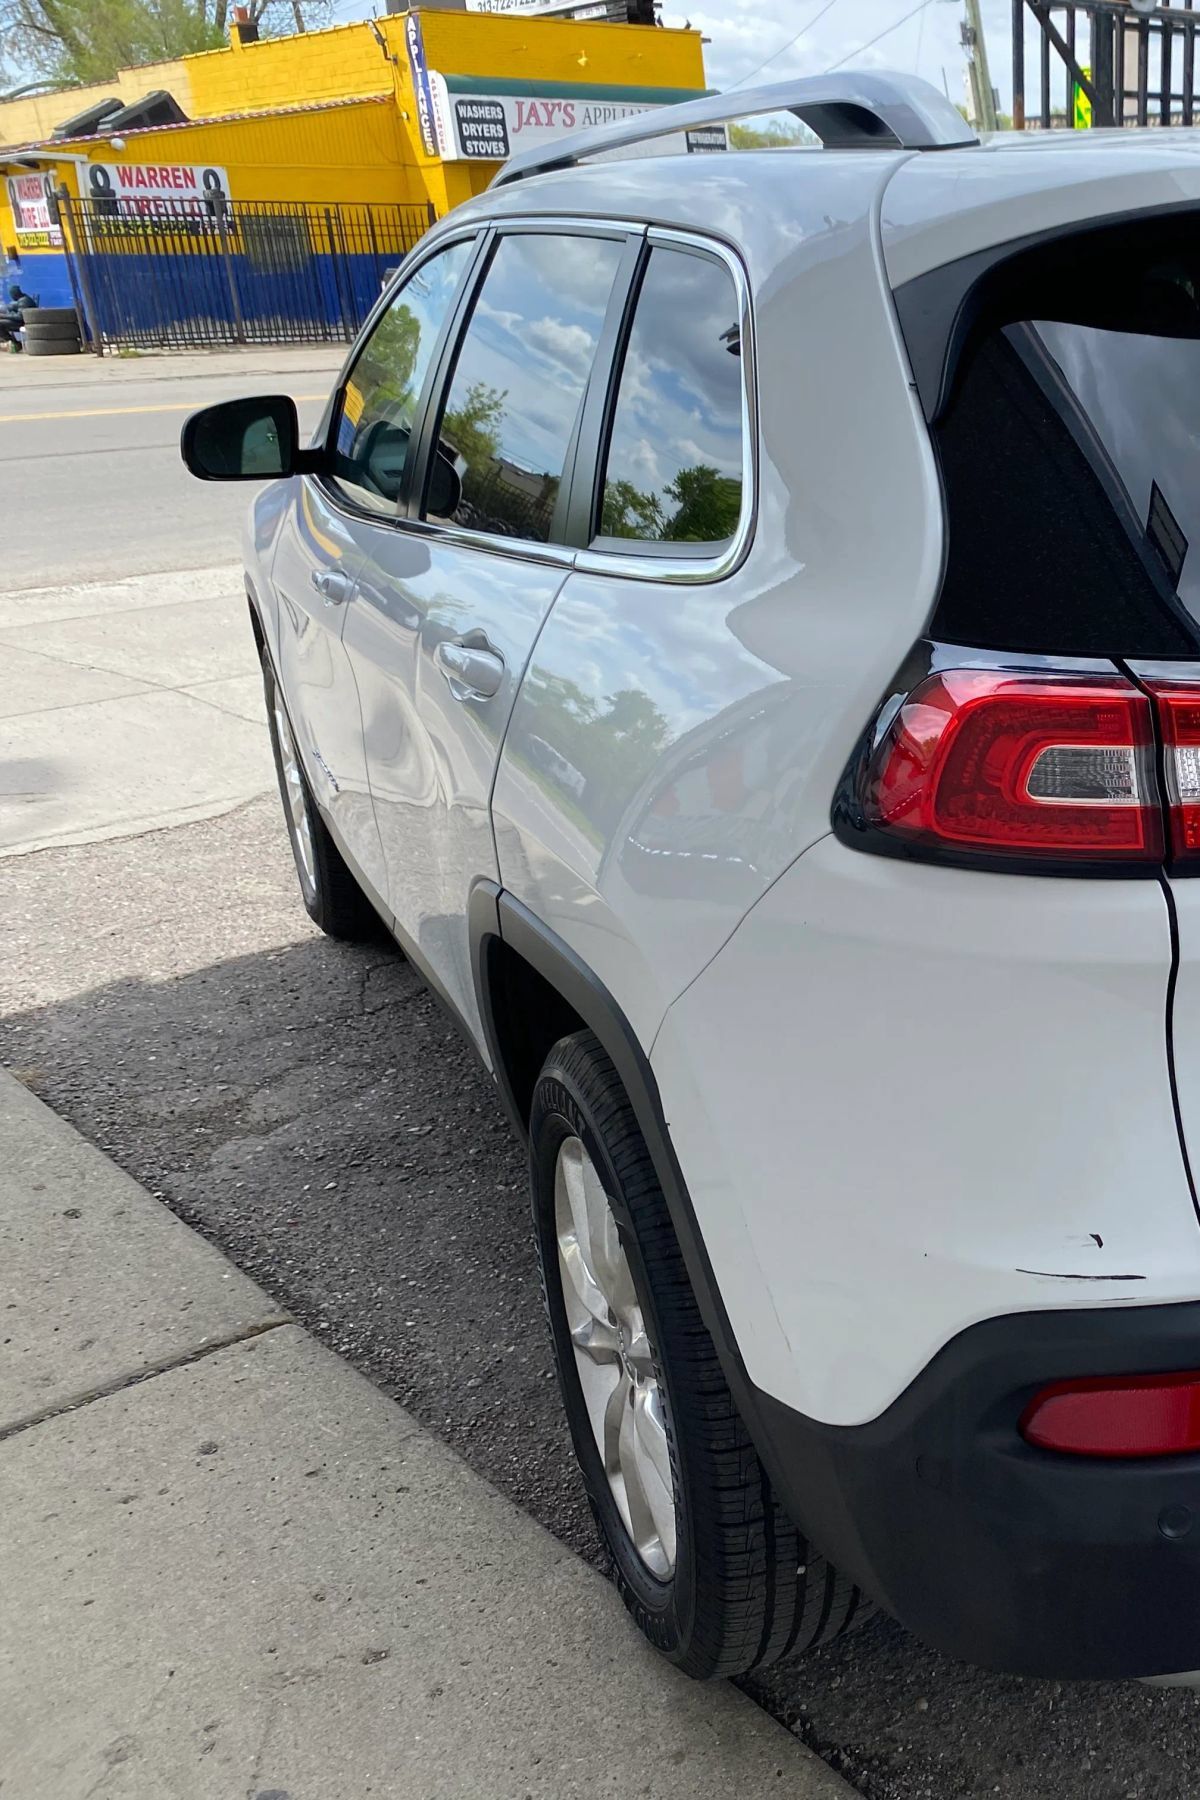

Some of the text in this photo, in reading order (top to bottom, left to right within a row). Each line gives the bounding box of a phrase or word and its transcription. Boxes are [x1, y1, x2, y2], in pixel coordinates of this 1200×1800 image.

[407, 17, 434, 156] APPLIANCES
[430, 77, 446, 152] APPLIANCES
[457, 104, 503, 120] WASHERS
[512, 101, 576, 133] JAY'S
[462, 123, 505, 138] DRYERS
[465, 140, 506, 155] STOVES
[115, 165, 197, 189] WARREN
[120, 195, 164, 216] TIRE
